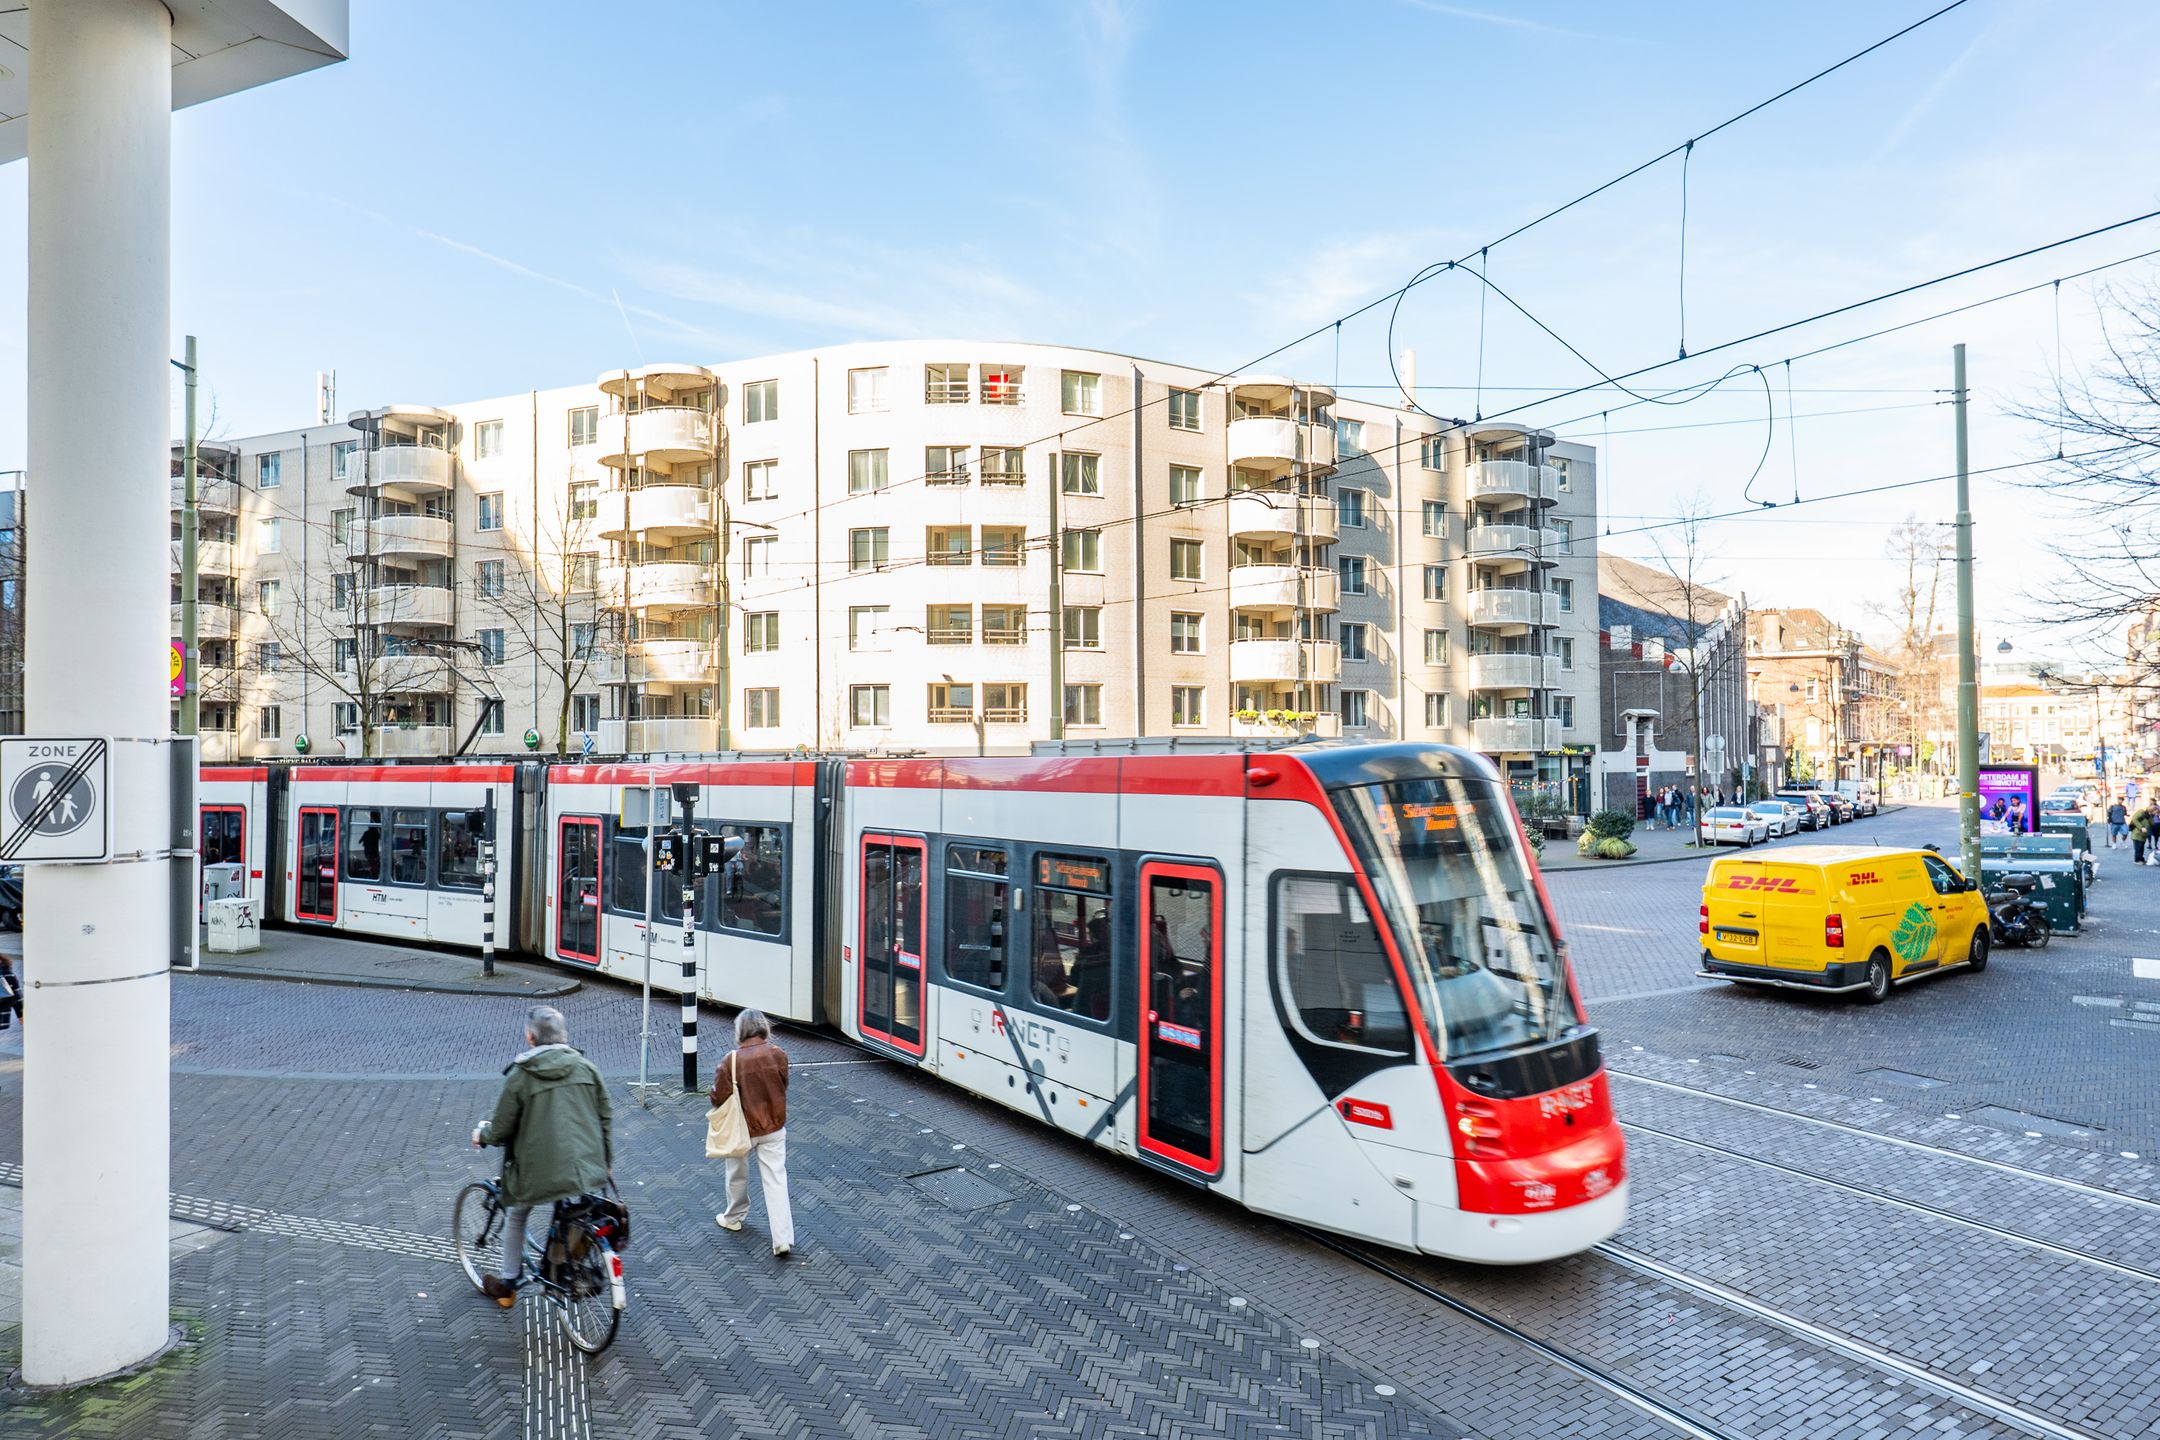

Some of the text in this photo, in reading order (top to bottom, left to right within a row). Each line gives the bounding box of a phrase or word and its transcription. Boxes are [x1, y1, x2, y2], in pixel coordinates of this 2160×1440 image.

[29, 745, 77, 757] ZONE
[1728, 876, 1800, 893] DHL
[1850, 872, 1879, 885] DHL
[372, 893, 387, 903] HTM
[641, 930, 657, 943] HM
